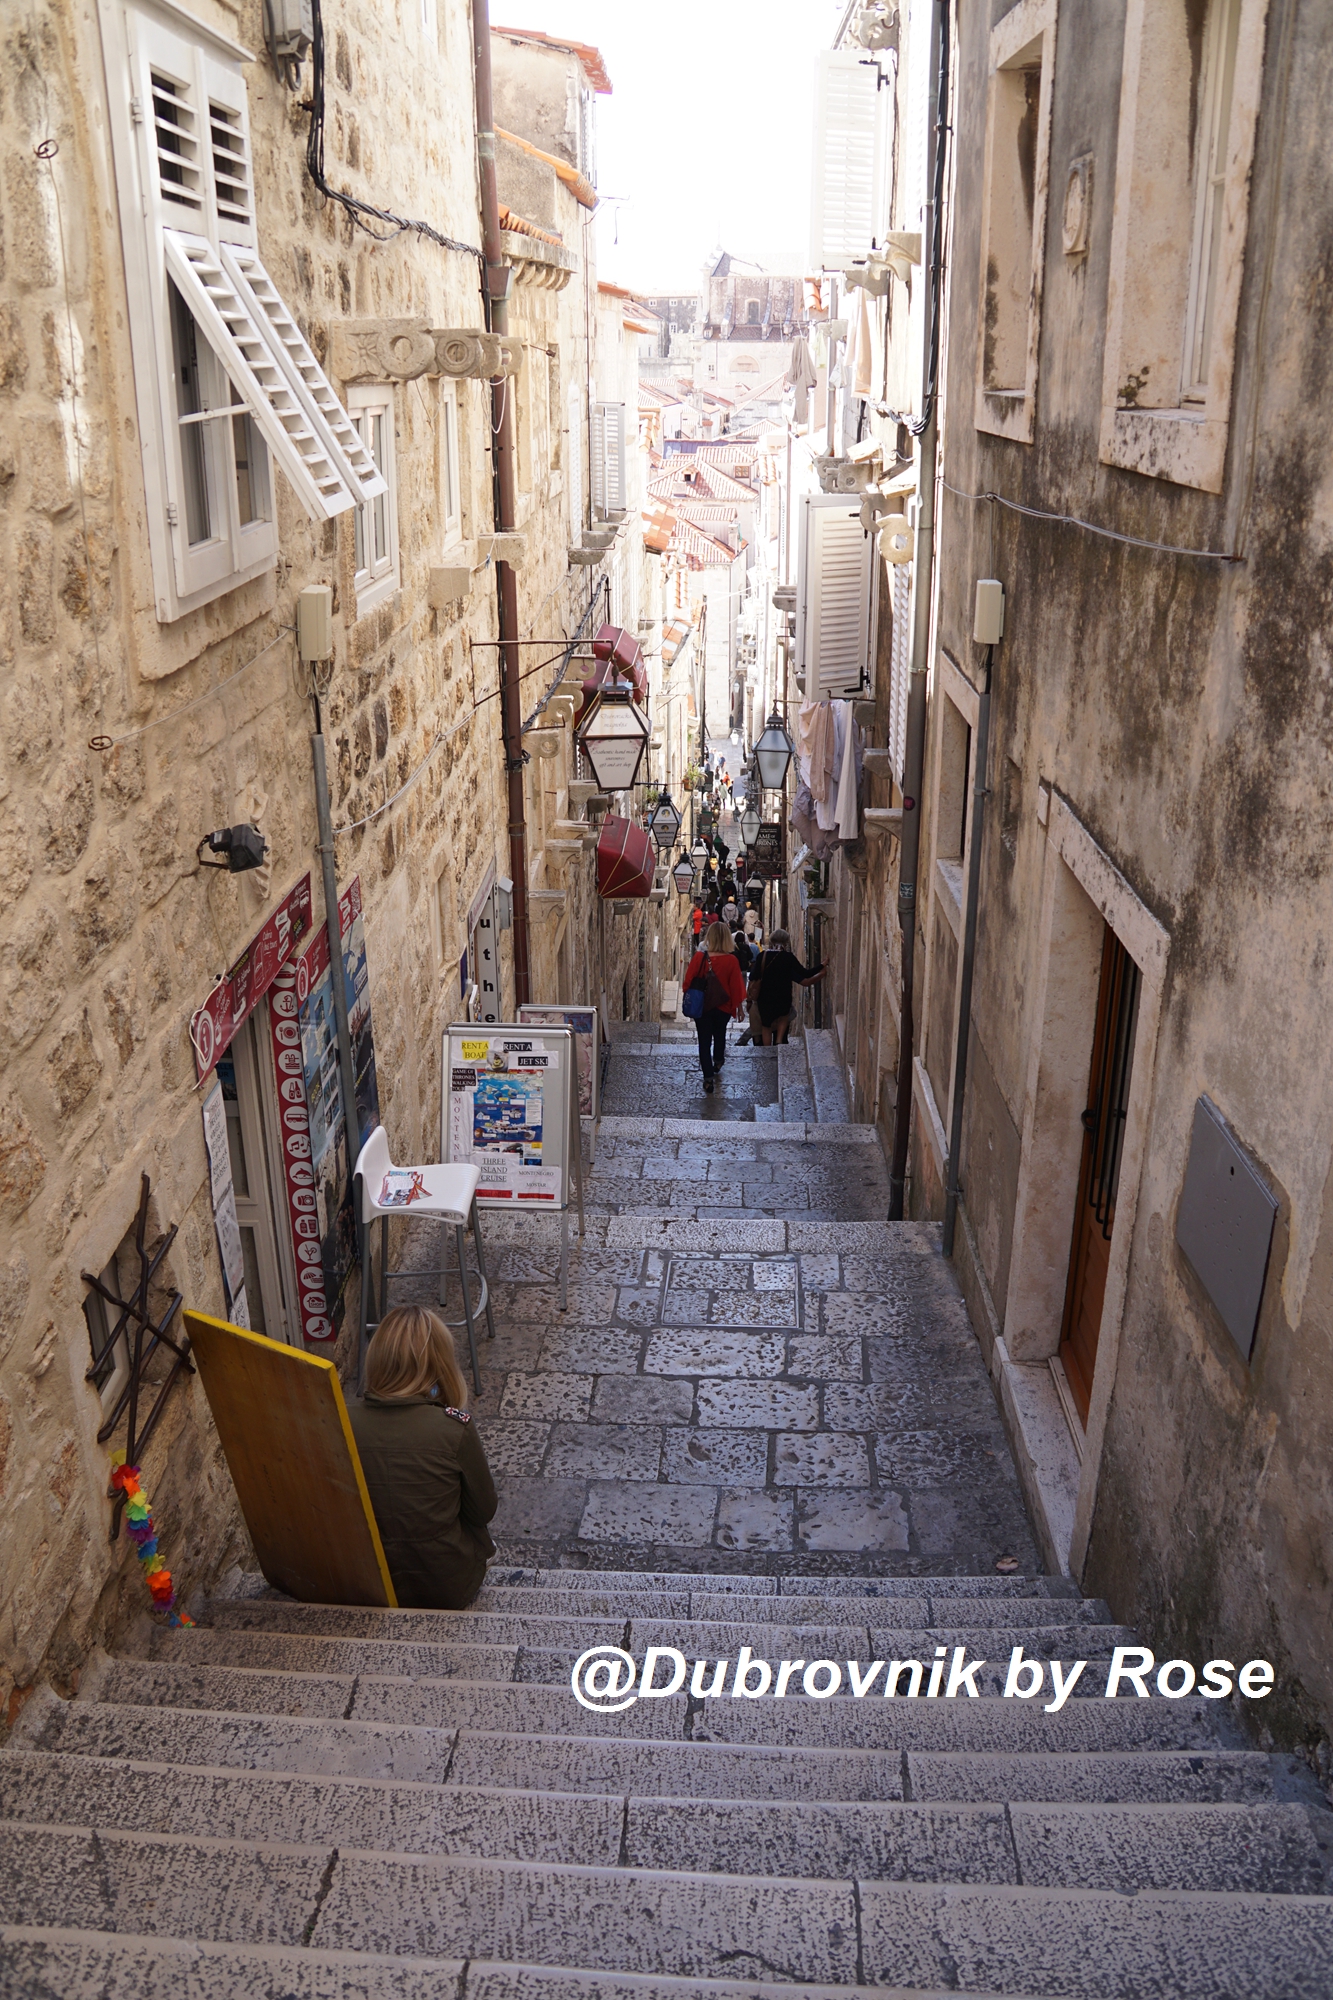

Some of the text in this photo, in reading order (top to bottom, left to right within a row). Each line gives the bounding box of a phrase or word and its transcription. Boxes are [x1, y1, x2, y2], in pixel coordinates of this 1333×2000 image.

[503, 1043, 532, 1051] RENT A
[520, 1057, 548, 1065] JET SKI
[453, 1097, 461, 1162] MONTENE
